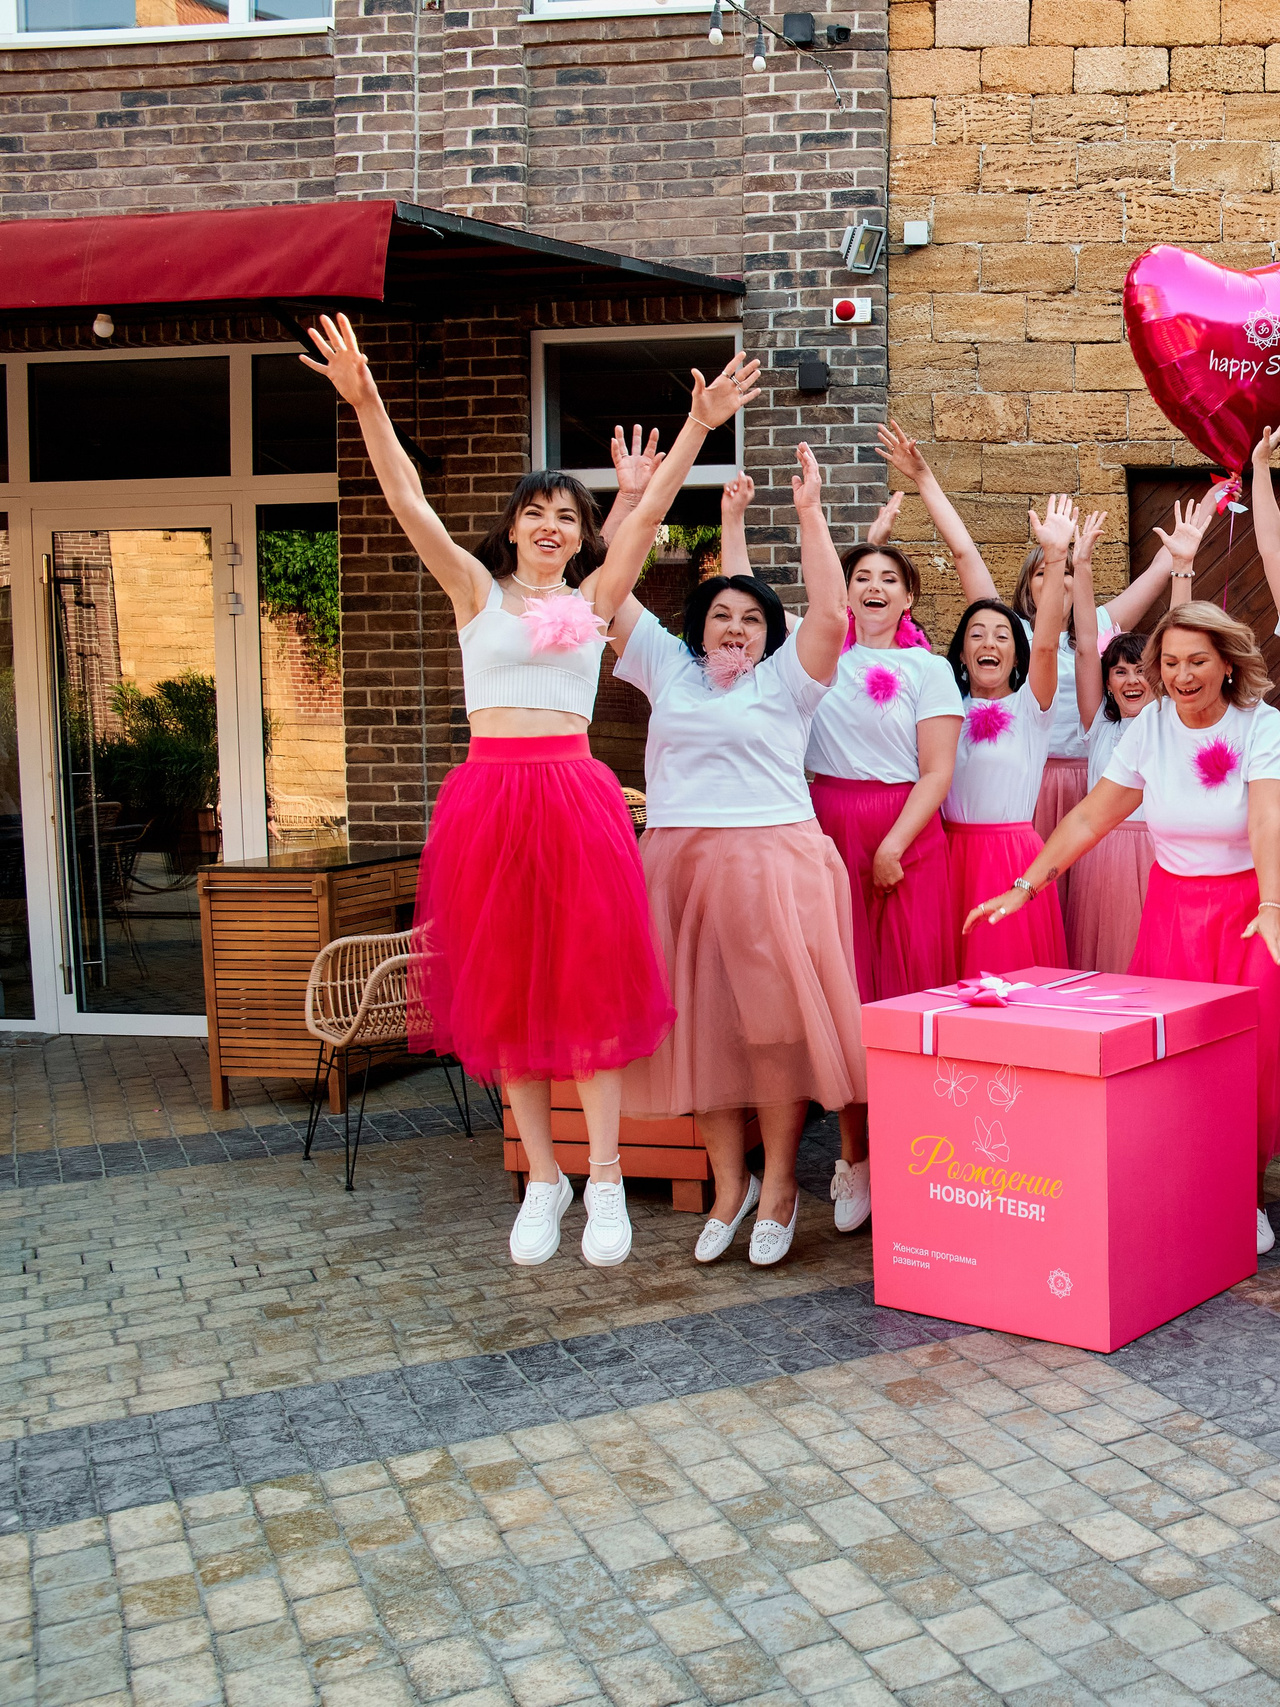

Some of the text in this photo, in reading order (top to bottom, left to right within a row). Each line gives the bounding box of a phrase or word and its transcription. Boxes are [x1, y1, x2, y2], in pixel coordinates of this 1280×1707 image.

[1208, 349, 1264, 382] happy
[908, 1134, 1064, 1203] Рождение
[929, 1182, 1047, 1222] НОВОЙ ТЕБЯ!
[892, 1241, 978, 1266] Женская программа
[892, 1255, 931, 1270] развития
